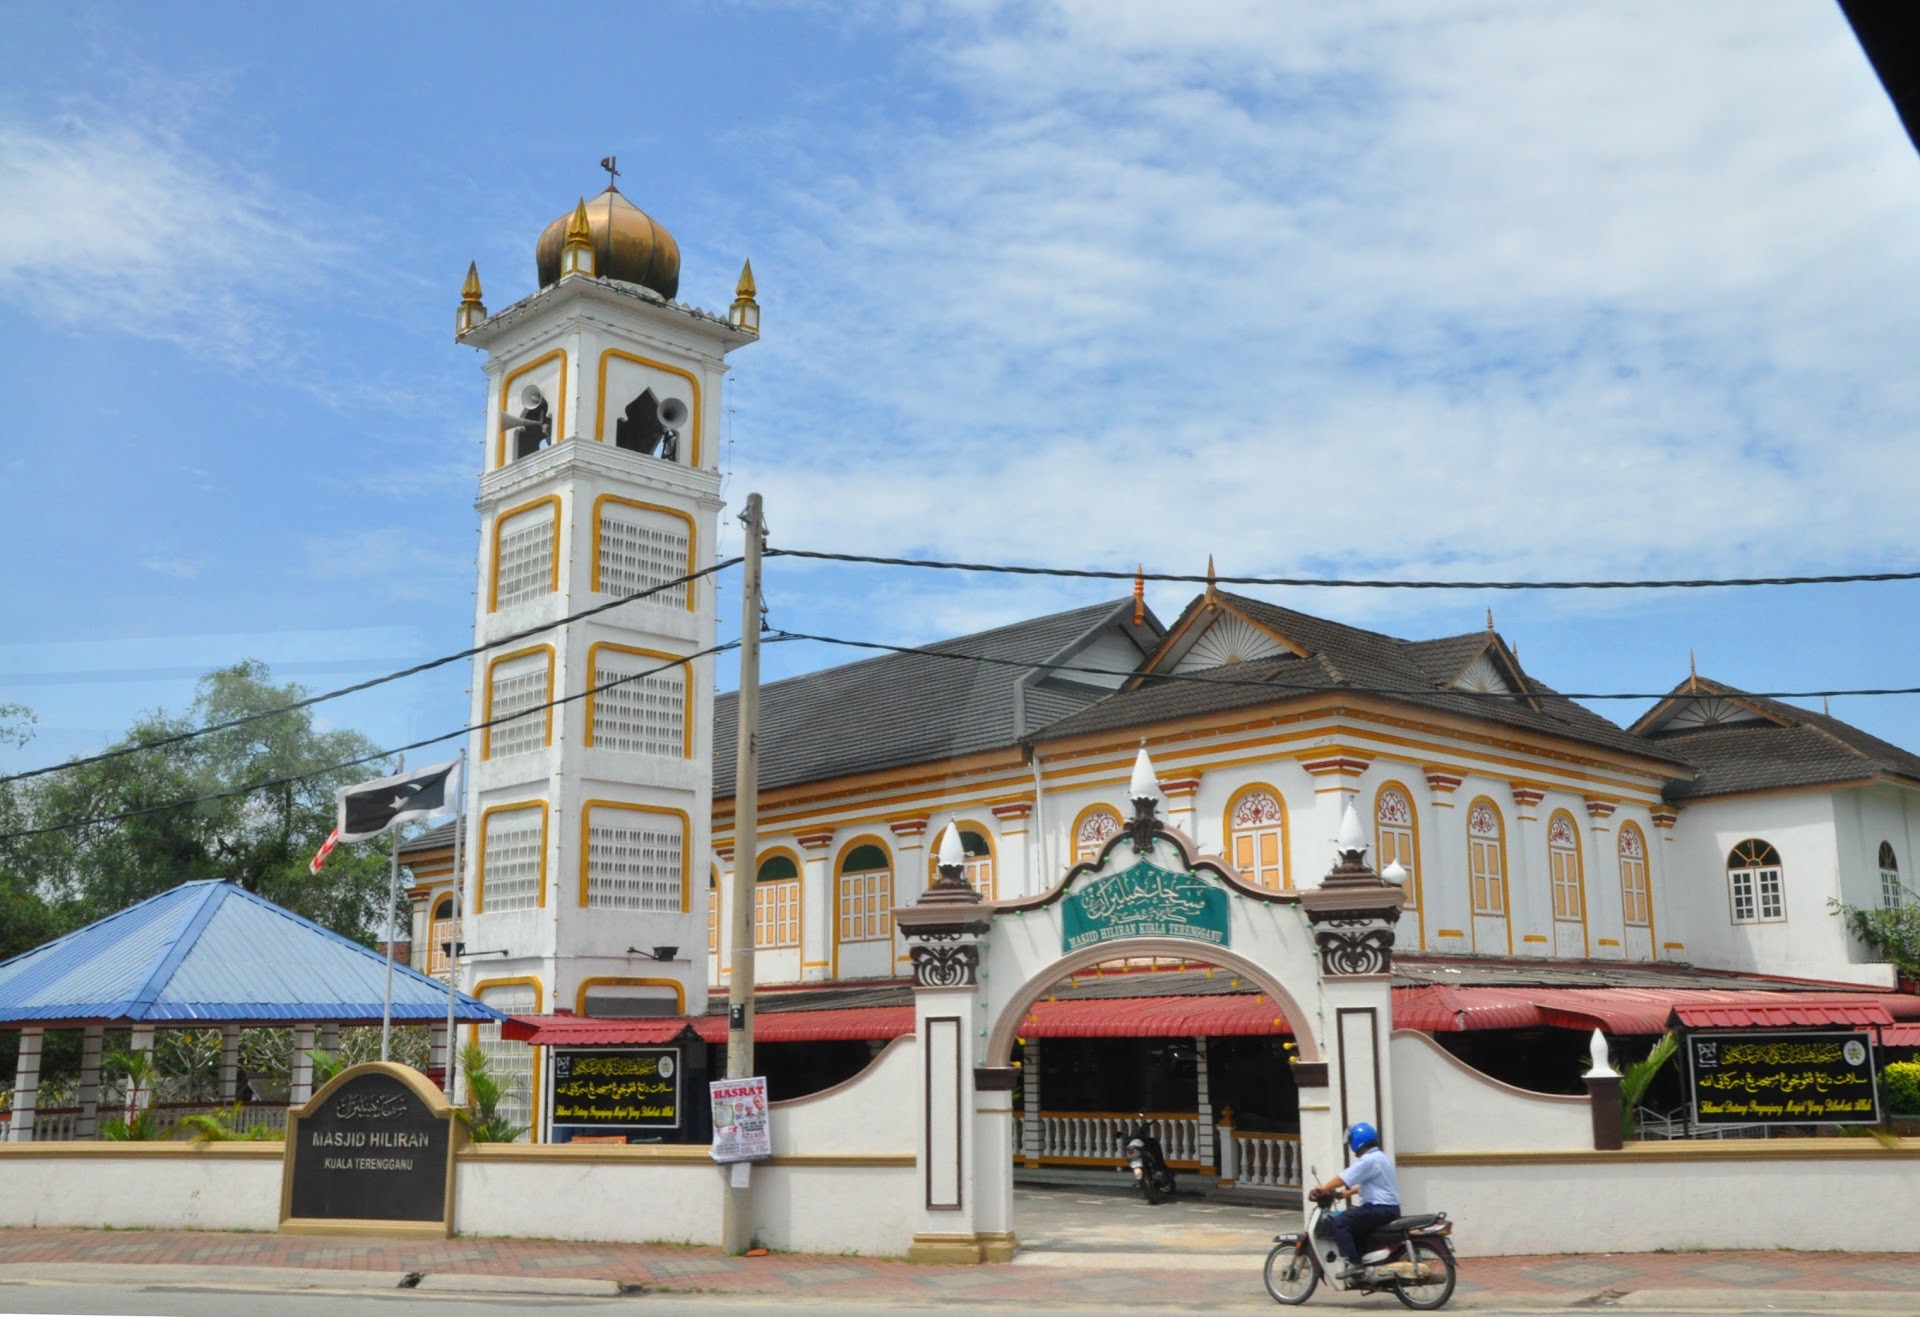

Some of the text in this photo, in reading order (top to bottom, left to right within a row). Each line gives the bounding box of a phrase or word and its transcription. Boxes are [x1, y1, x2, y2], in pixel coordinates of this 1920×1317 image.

[1068, 922, 1224, 949] MASJID HILIRAN KUALA TERENGGANU
[713, 1086, 764, 1099] HASRAT
[312, 1132, 429, 1147] MASJID HILIRAN
[325, 1158, 413, 1170] KUALA TERENGGANU
